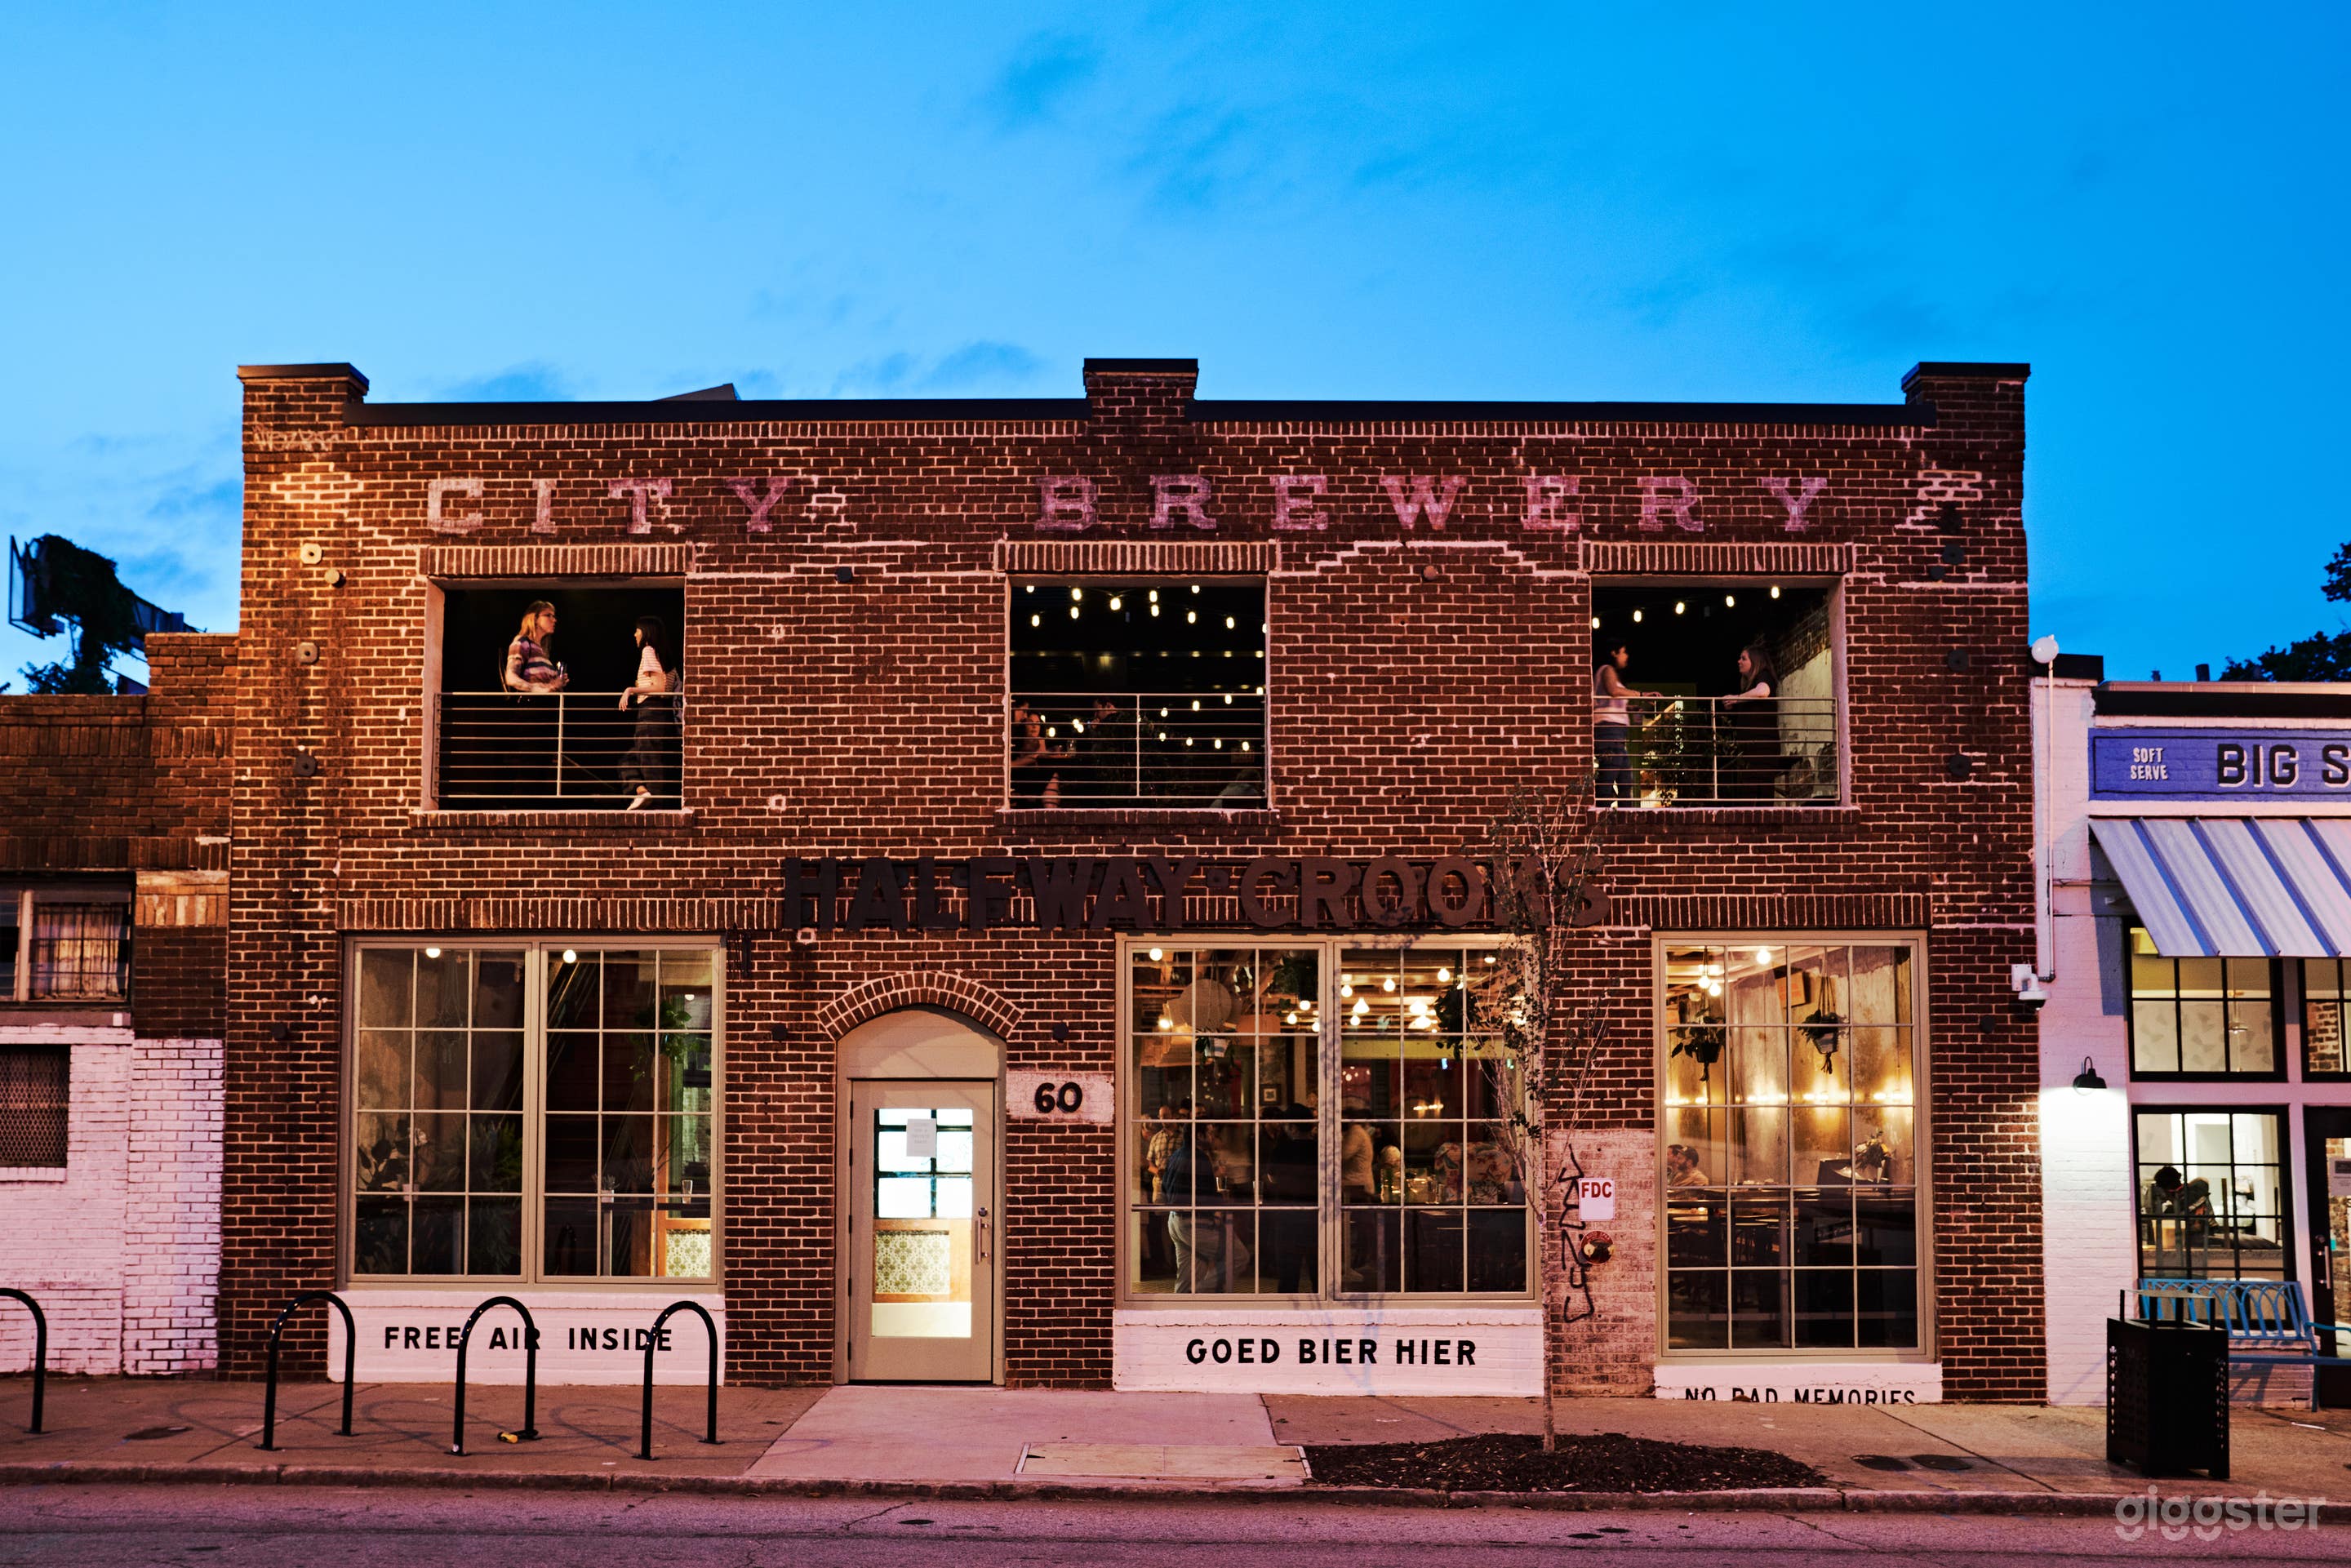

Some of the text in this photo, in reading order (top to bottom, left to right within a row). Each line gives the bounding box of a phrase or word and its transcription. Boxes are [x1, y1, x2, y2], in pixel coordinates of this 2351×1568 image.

[426, 475, 1828, 535] CITY BREWERY
[2132, 747, 2165, 763] SOFT
[2217, 744, 2300, 788] BIG
[2130, 765, 2169, 781] SERVE
[783, 855, 1611, 931] HALFWAY CROOKS
[1034, 1082, 1083, 1113] 60
[1580, 1181, 1613, 1199] FDC
[384, 1326, 463, 1349] FREE
[569, 1327, 672, 1351] INSIDE
[1185, 1339, 1477, 1366] GOED BIER HIER
[1685, 1388, 1716, 1401] NO
